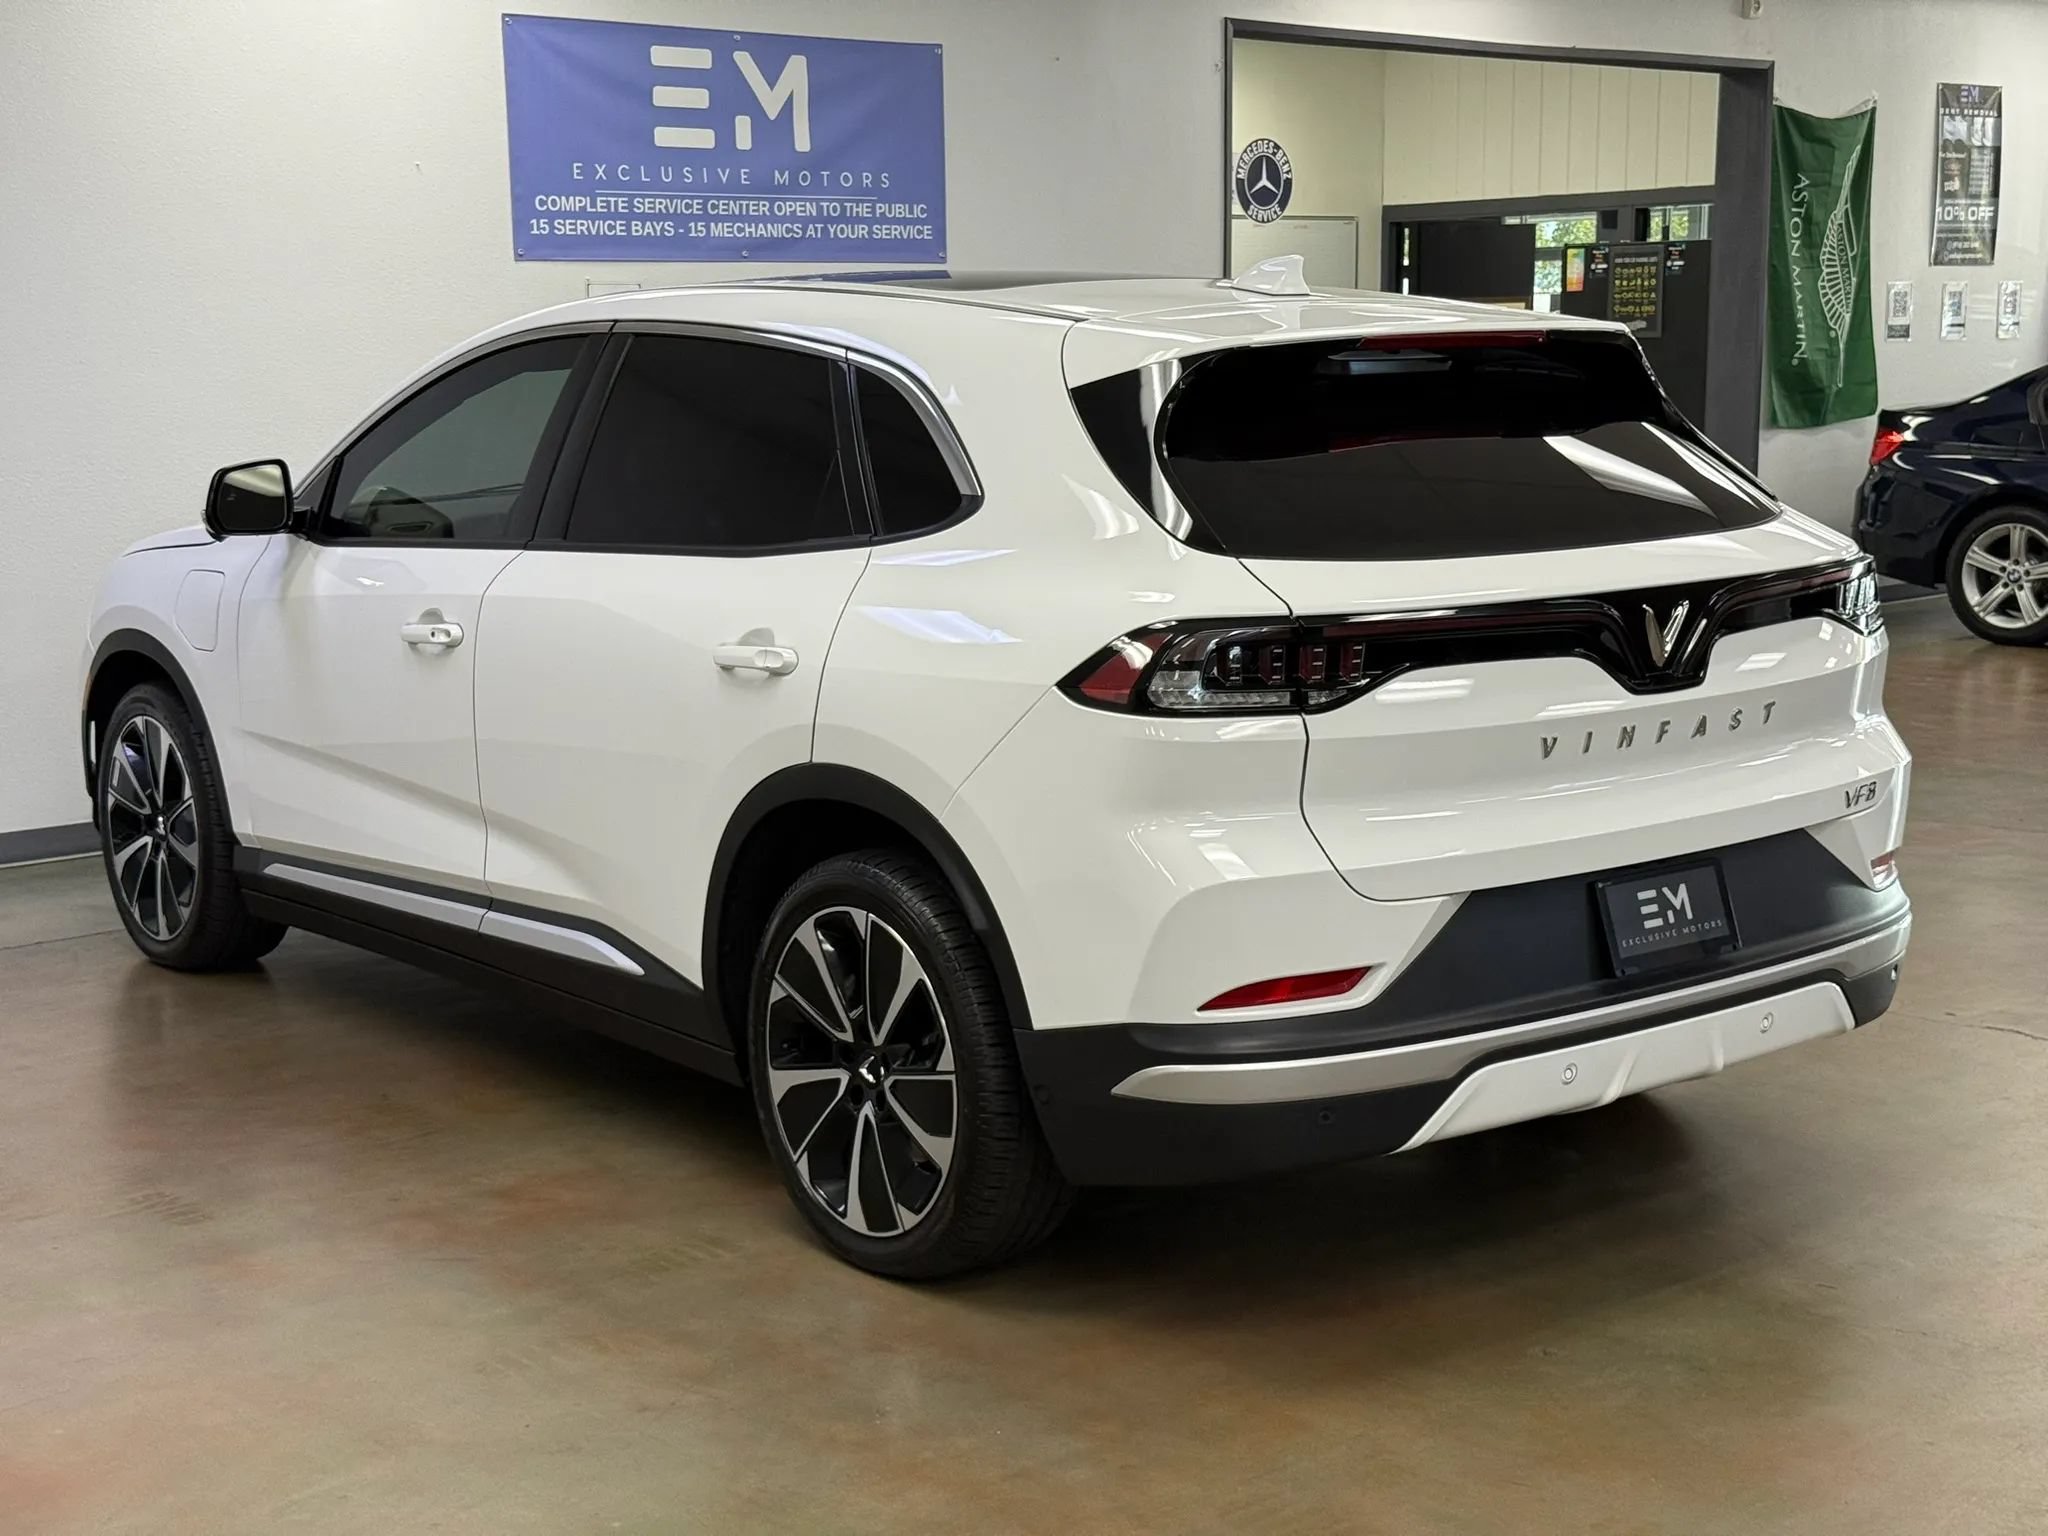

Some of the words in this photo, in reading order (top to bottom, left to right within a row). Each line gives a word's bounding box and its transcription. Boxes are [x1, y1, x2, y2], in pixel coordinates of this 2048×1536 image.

[650, 45, 811, 152] EM
[1236, 140, 1292, 180] MERCEDES-BENZ
[572, 162, 752, 186] EXCLUSIVE
[774, 170, 891, 189] MOTORS
[535, 195, 629, 213] COMPLETE
[633, 197, 703, 215] SERVICE
[707, 199, 770, 216] CENTER
[774, 201, 817, 217] OPEN
[820, 202, 841, 217] TO
[844, 202, 873, 218] THE
[876, 203, 928, 219] PUBLIC
[1247, 204, 1282, 222] SERVICE
[1789, 172, 1812, 257] ASTON
[1936, 206, 1965, 221] 10%
[1968, 206, 1995, 221] OFF
[529, 219, 550, 235] 15
[553, 219, 628, 236] SERVICE
[631, 220, 675, 237] BAYS
[688, 222, 707, 237] 15
[710, 222, 802, 238] MECHANICS
[805, 223, 824, 239] AT
[827, 224, 869, 239] YOUR
[872, 224, 933, 240] SERVICE
[1791, 265, 1808, 359] MARTIN
[1540, 700, 1777, 760] VINFAST
[1844, 780, 1878, 809] VF8
[1637, 883, 1693, 929] EM
[1622, 928, 1678, 948] EXCLUSIVE
[1682, 919, 1723, 934] MOTORS
